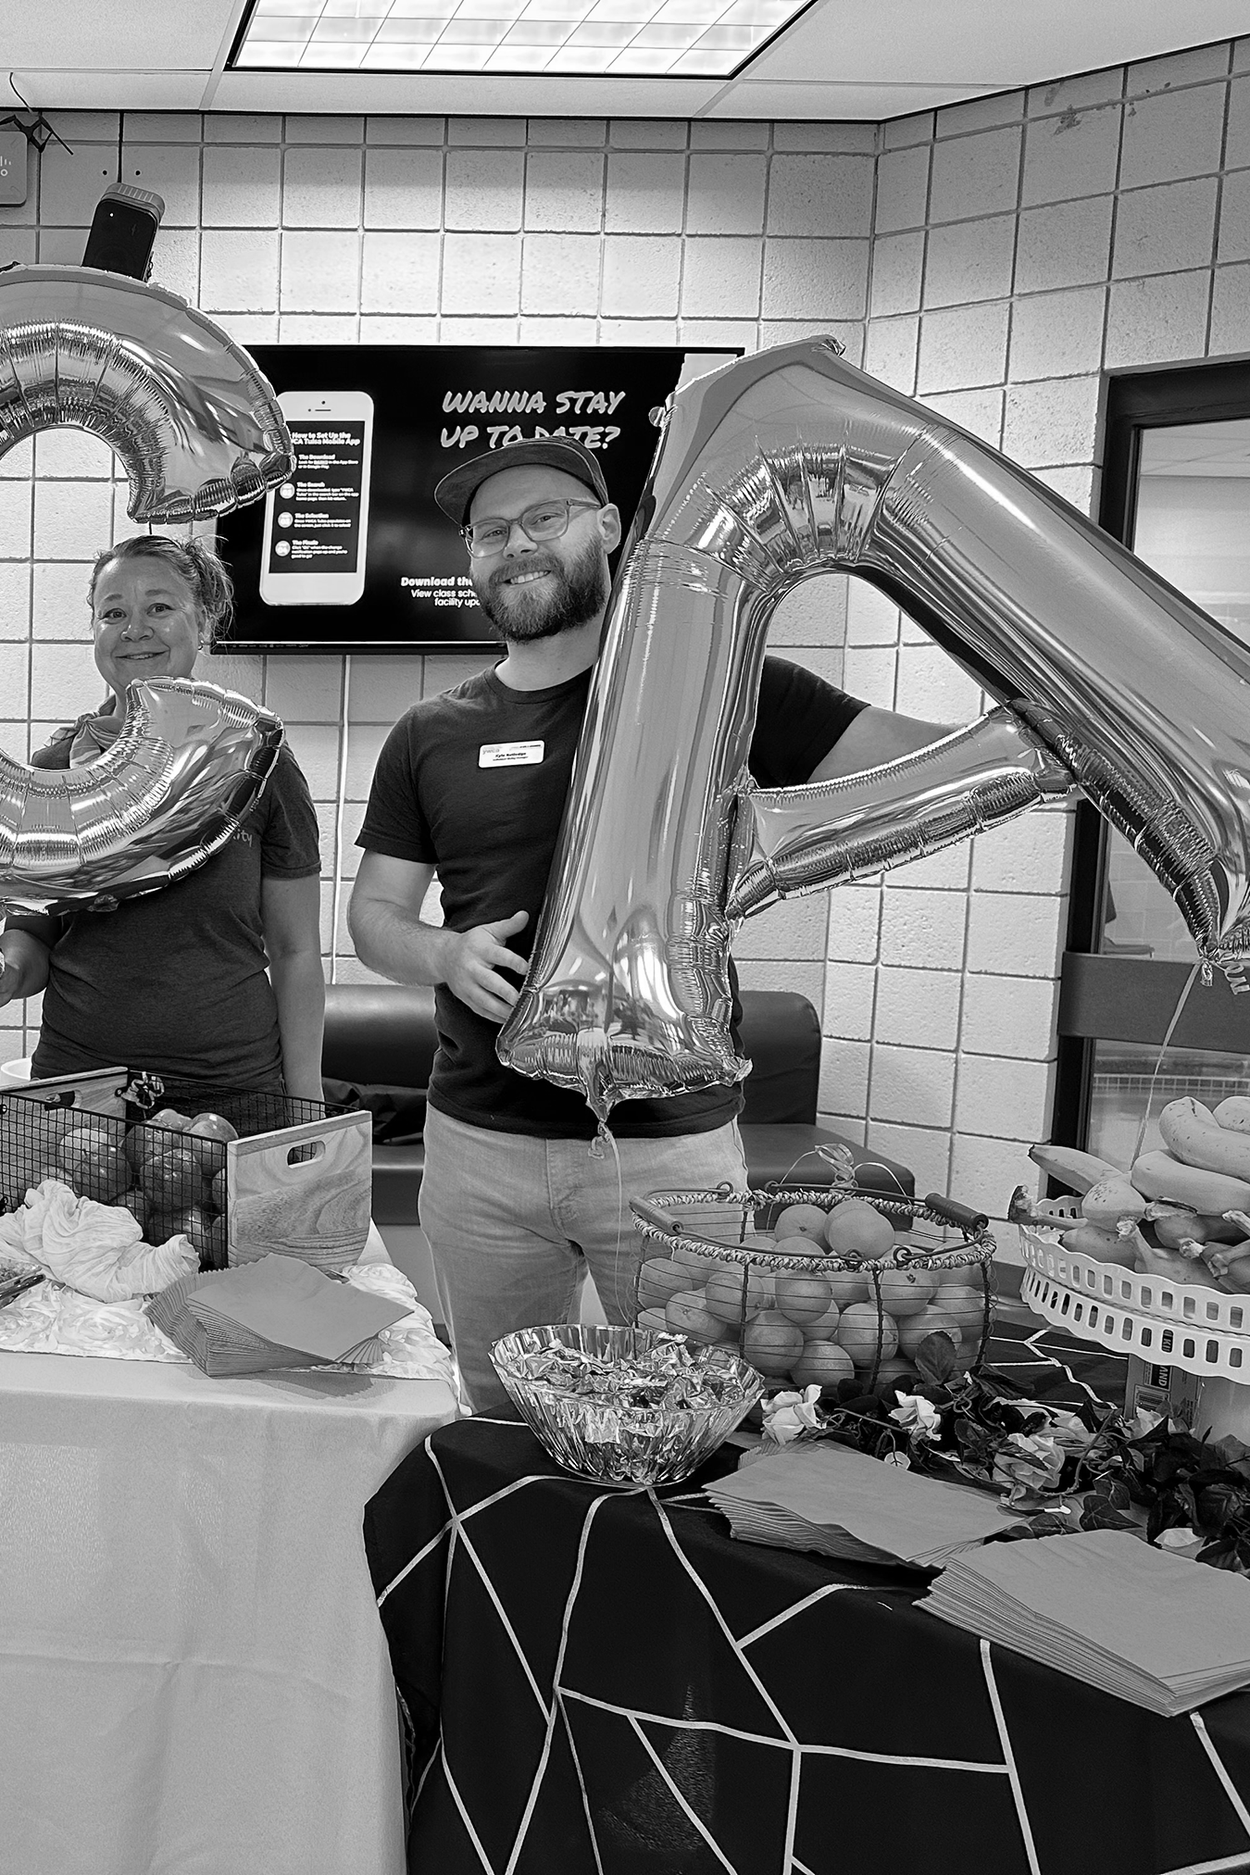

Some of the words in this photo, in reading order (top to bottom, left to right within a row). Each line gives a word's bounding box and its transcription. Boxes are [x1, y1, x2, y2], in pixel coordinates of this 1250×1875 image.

[442, 390, 547, 414] WANNA
[555, 391, 626, 415] STAY
[440, 425, 479, 449] UP
[486, 425, 524, 449] TO
[400, 576, 455, 587] Download
[411, 589, 433, 598] View
[433, 589, 457, 598] class
[434, 598, 464, 608] facility
